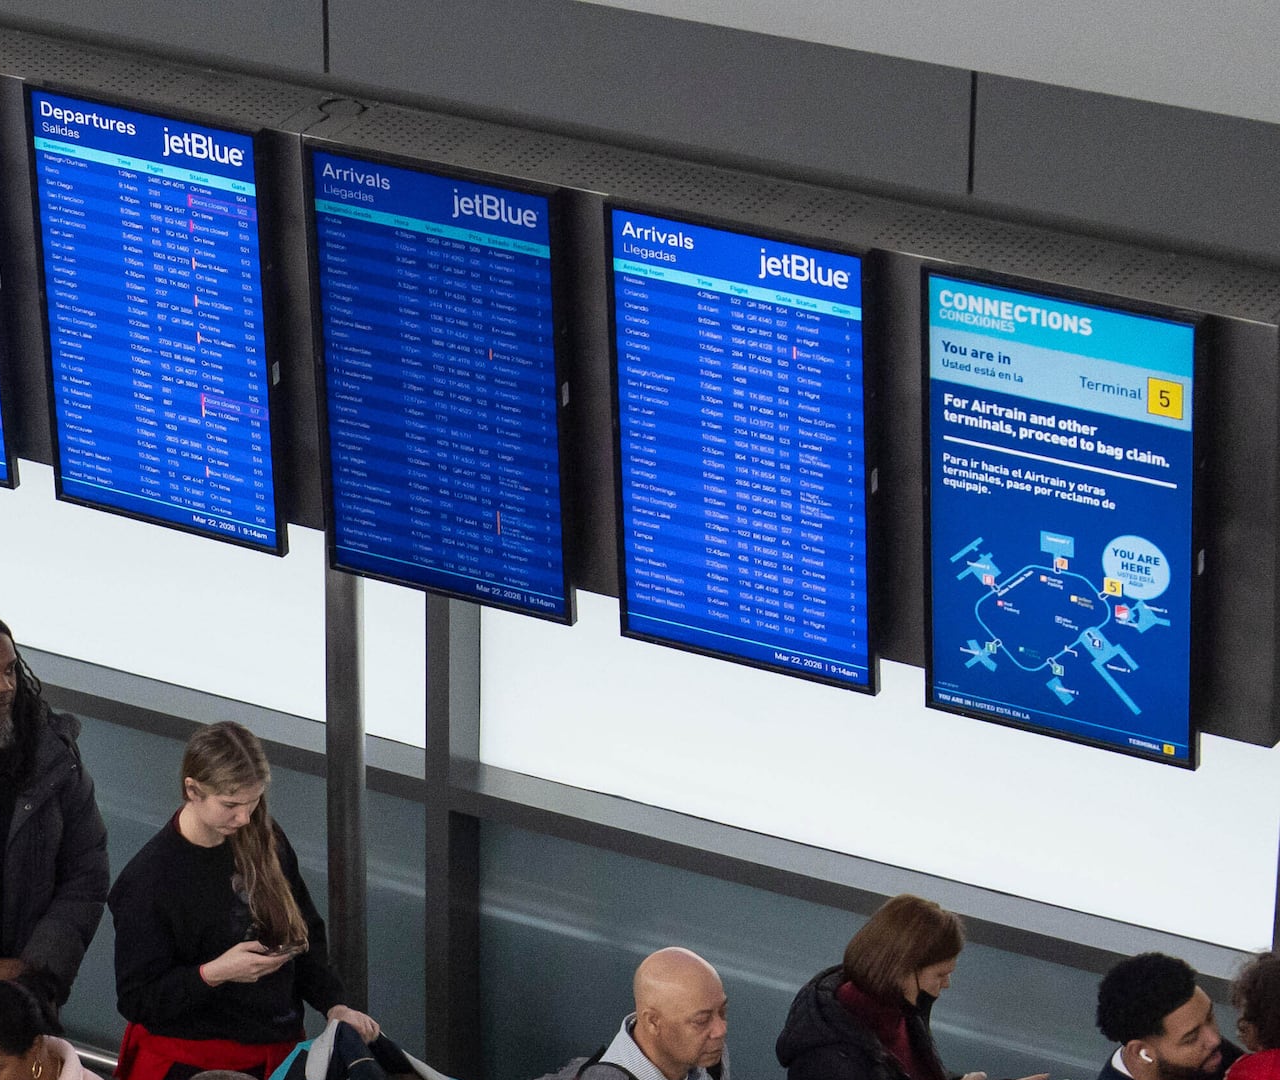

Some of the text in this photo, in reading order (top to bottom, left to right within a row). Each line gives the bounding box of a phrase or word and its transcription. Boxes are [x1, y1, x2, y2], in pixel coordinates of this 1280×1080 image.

[41, 101, 135, 135] Departures
[41, 120, 80, 138] Salidas
[164, 128, 242, 166] jetBlue
[323, 163, 390, 190] Arrivals
[322, 184, 374, 202] Llegadas
[453, 189, 536, 227] jetBlue
[622, 222, 693, 249] Arrivals
[624, 243, 676, 262] Llegadas
[759, 249, 848, 288] jetBlue
[938, 288, 1093, 336] CONNECTIONS
[938, 306, 1015, 334] CONEXIONES
[942, 340, 1010, 364] You are in
[941, 358, 1024, 382] Usted está en la
[1080, 376, 1170, 408] Terminal 5
[943, 391, 1098, 438] For Airtrain and other
[943, 408, 1170, 468] terminals, proceed to bag claim.
[942, 451, 1106, 497] Para ir hacia el Airtrain y otras
[942, 474, 992, 496] equipaje.
[942, 464, 1116, 511] terminales, pase por reclamo de
[191, 513, 206, 524] Mar
[242, 526, 268, 539] 9:14am
[1112, 548, 1160, 566] YOU ARE
[1120, 562, 1150, 576] HERE
[475, 582, 490, 594] Mar
[1108, 581, 1117, 593] 5
[1092, 638, 1101, 648] 4
[774, 652, 790, 662] Mar
[830, 665, 858, 678] 9:14am
[937, 692, 951, 701] YOU
[950, 695, 963, 704] ARE
[963, 698, 972, 706] IN
[974, 700, 995, 712] USTED
[1127, 737, 1160, 751] TERMINAL
